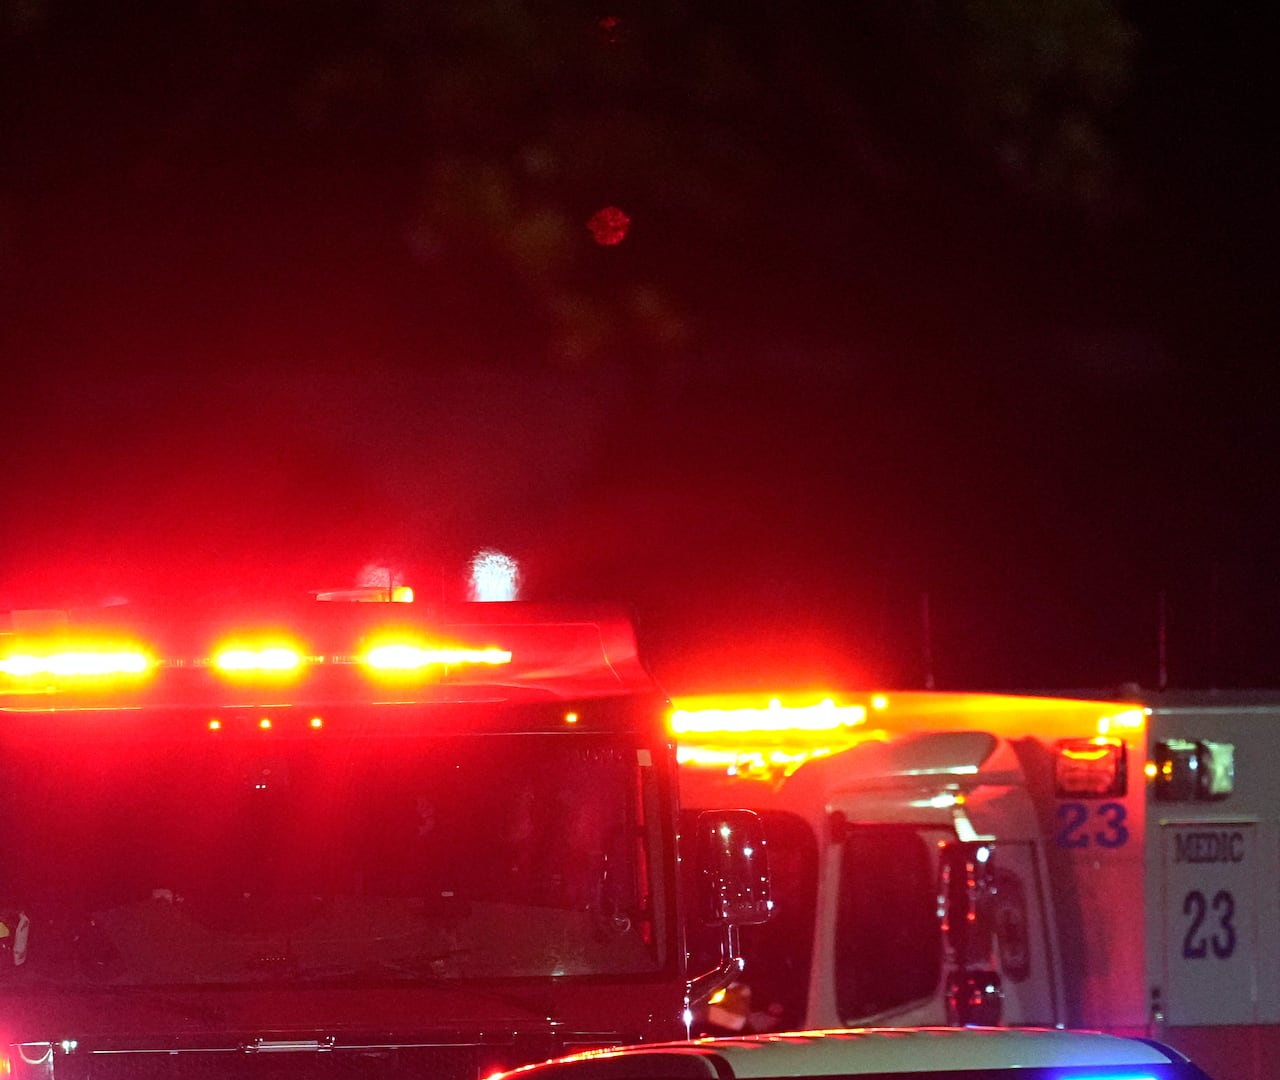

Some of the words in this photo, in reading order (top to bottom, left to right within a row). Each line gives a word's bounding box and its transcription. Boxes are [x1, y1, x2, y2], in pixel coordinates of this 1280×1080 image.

[1056, 803, 1129, 849] 23
[1175, 832, 1245, 864] MEDIC
[1183, 890, 1237, 959] 23
